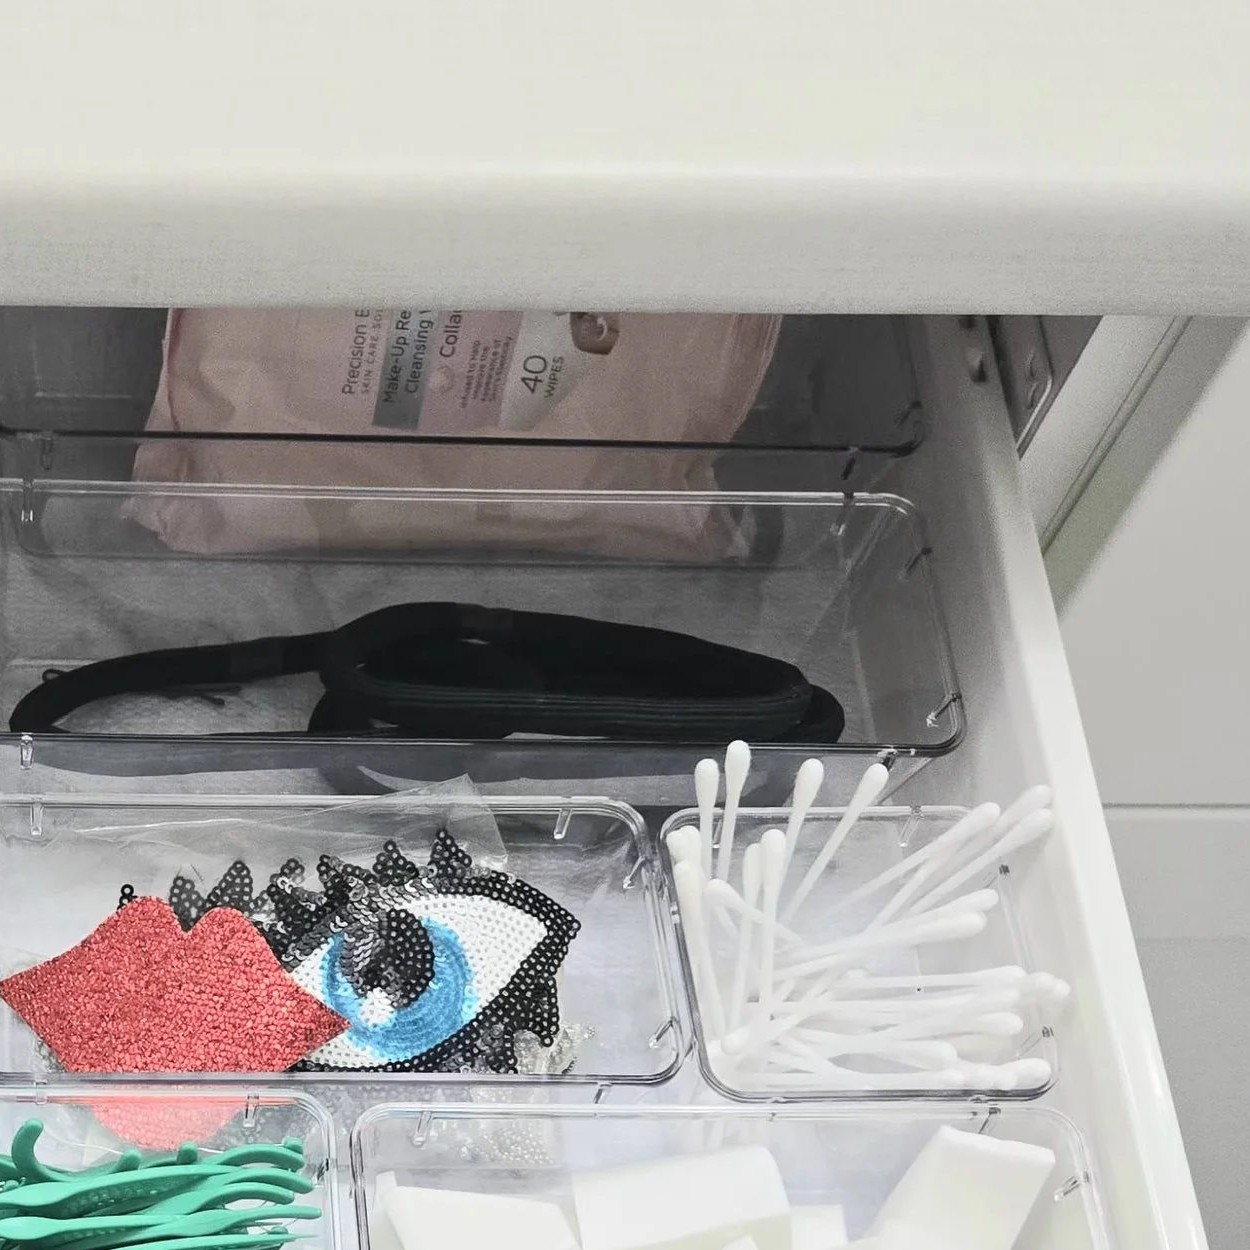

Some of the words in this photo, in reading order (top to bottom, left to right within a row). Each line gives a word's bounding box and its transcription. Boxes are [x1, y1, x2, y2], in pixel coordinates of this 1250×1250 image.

[342, 323, 367, 395] Precision
[382, 336, 409, 404] Make-Up
[406, 318, 434, 394] Cleansing
[521, 355, 548, 394] 40
[544, 356, 565, 399] WIPES
